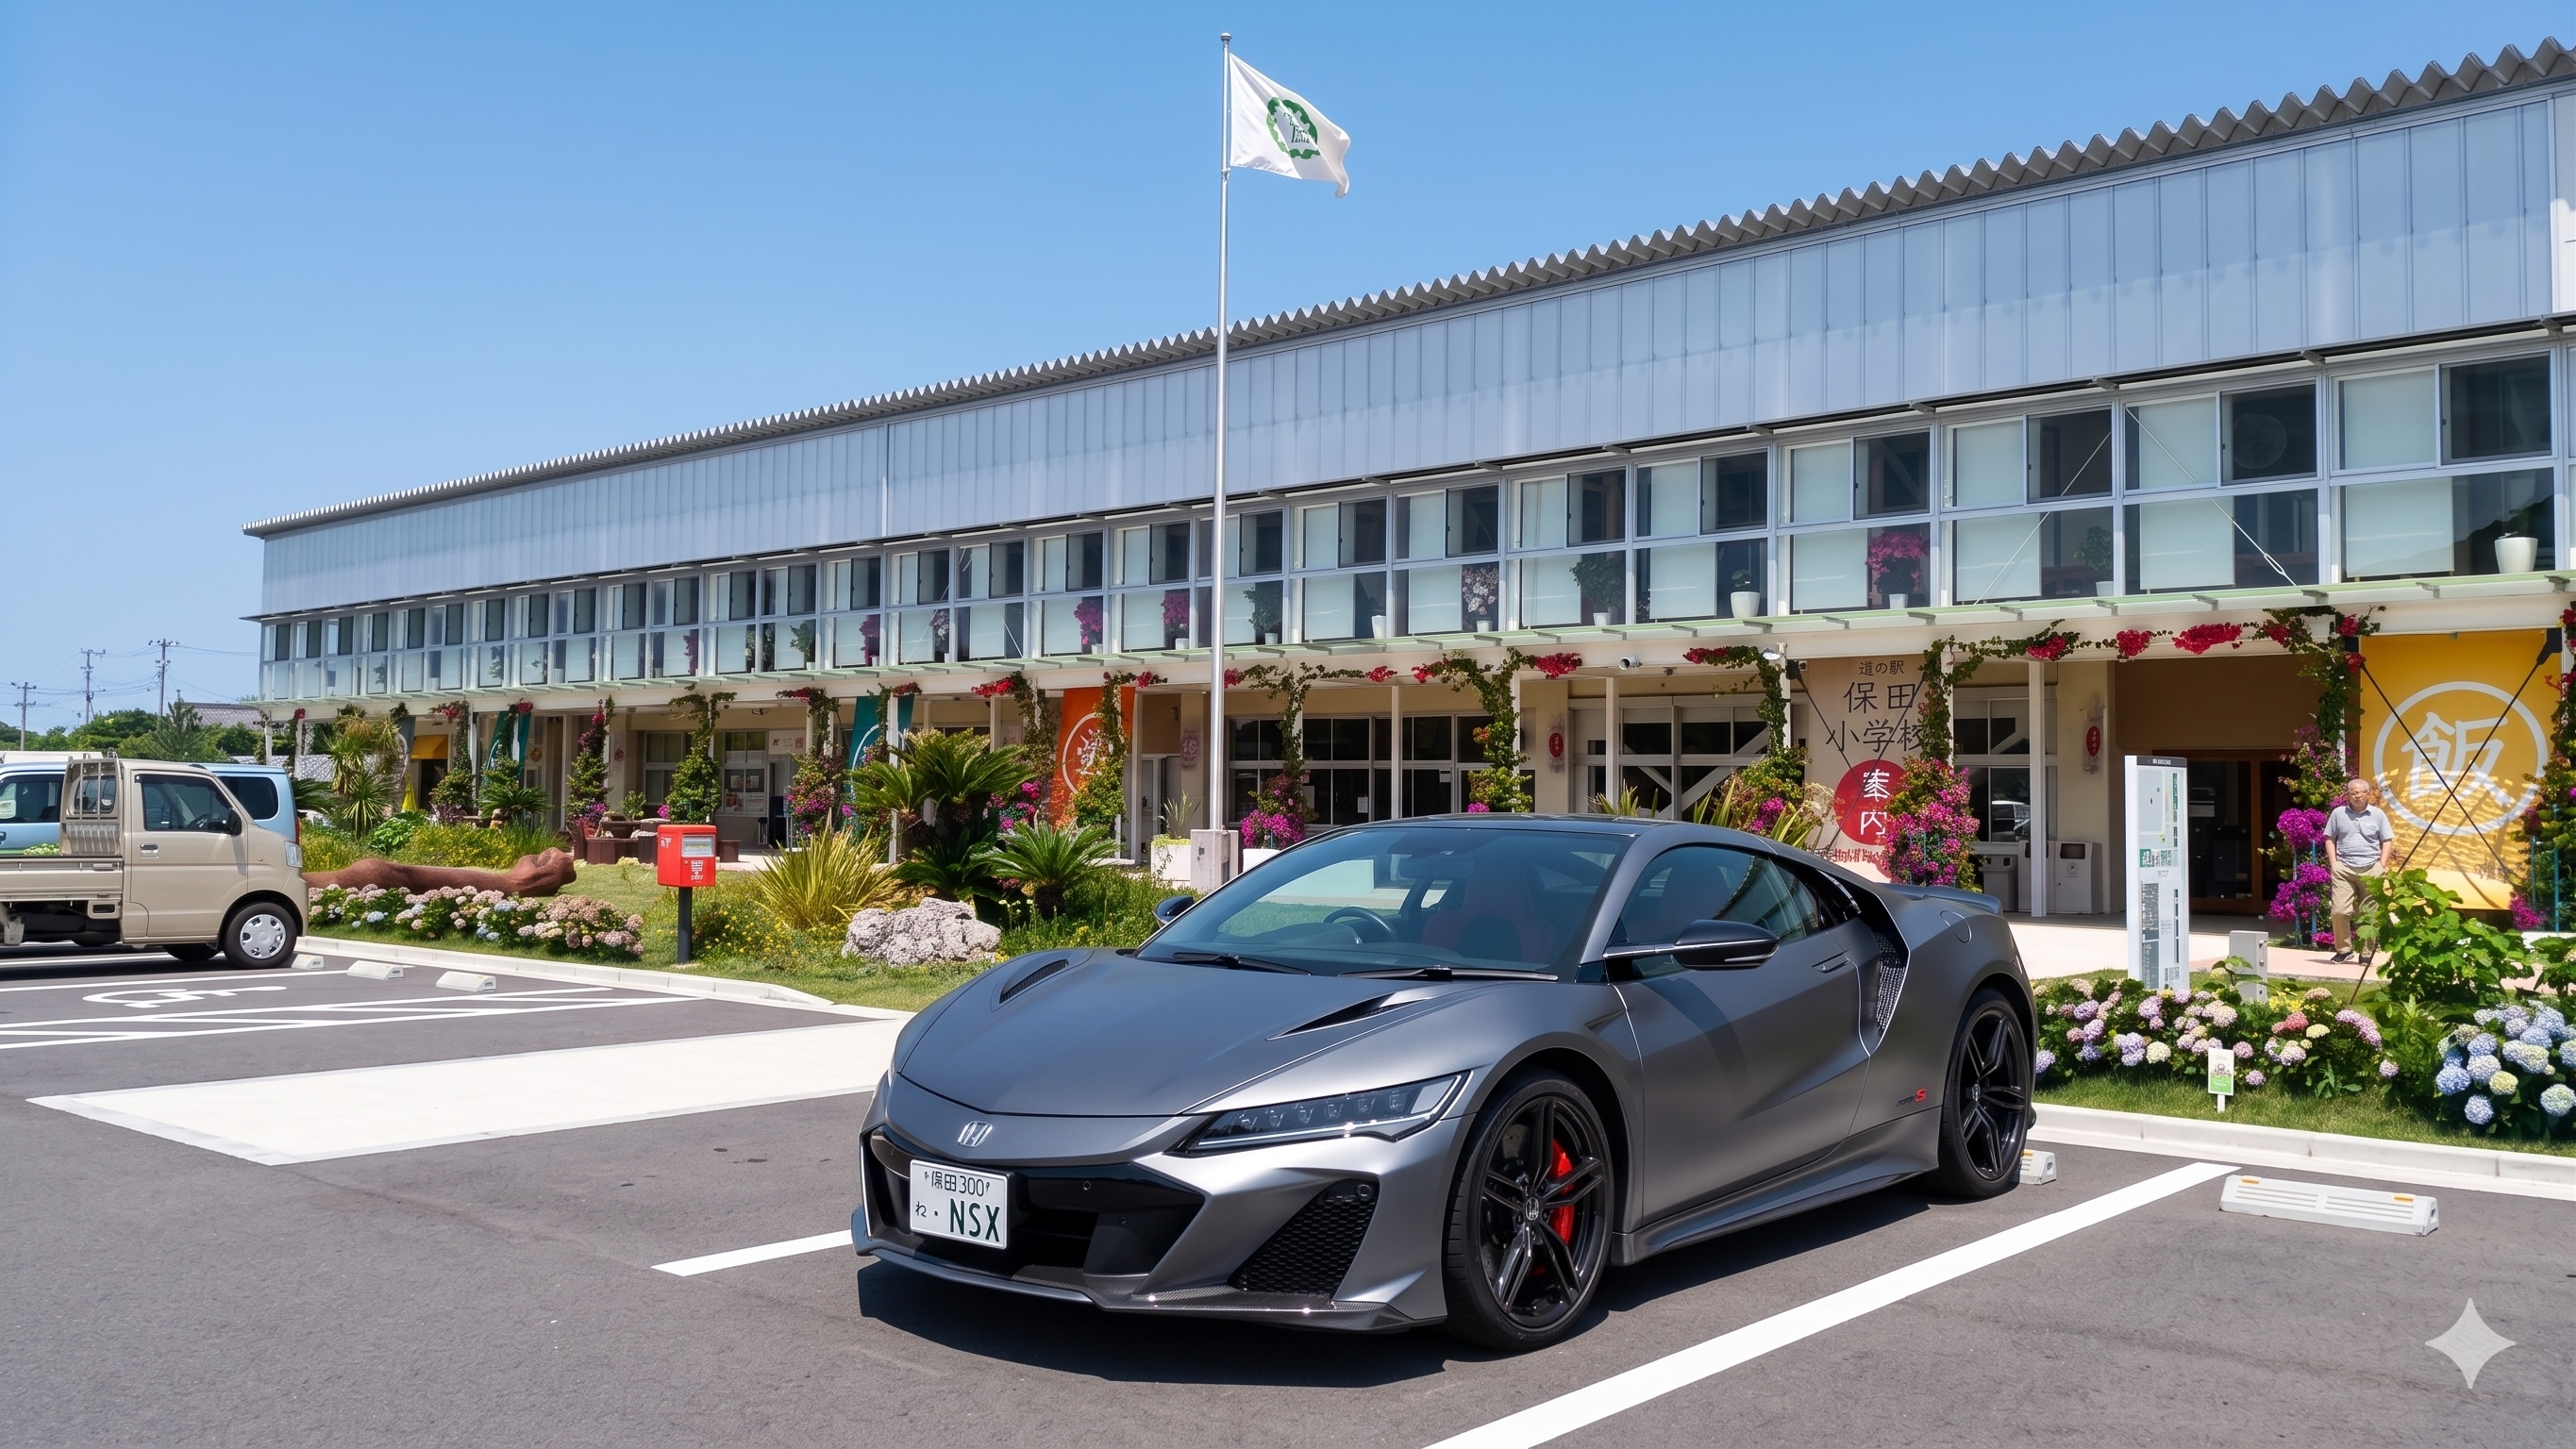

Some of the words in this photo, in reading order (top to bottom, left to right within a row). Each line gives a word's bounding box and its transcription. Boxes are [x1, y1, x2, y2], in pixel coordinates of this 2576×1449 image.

[1858, 660, 1904, 676] 道の駅
[1843, 681, 1915, 714] 保田
[1825, 718, 1923, 754] 小学校
[2400, 711, 2517, 808] 飯
[949, 1198, 1000, 1242] NSX
